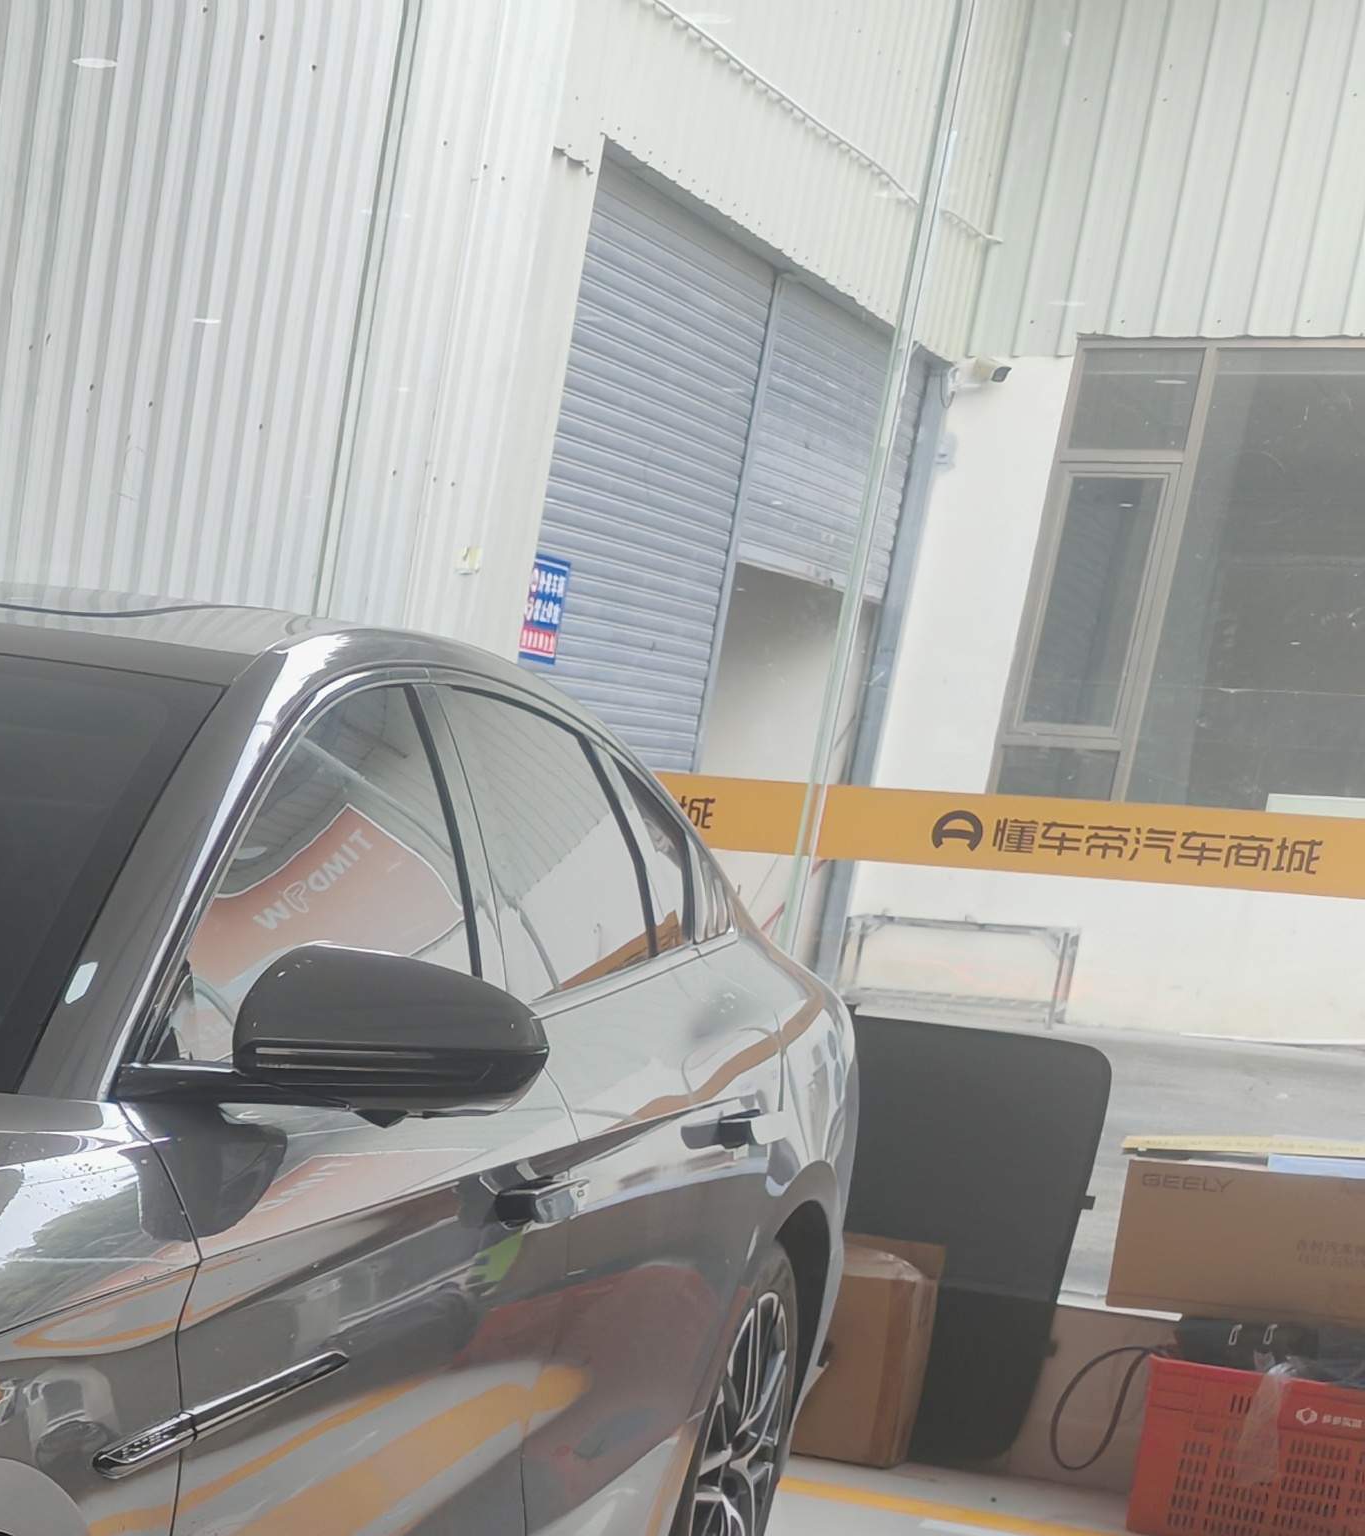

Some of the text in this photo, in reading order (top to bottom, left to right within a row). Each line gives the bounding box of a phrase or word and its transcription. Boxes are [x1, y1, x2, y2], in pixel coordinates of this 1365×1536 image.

[992, 816, 1324, 875] 懂车帝汽车商城
[1141, 1172, 1235, 1193] GEELY
